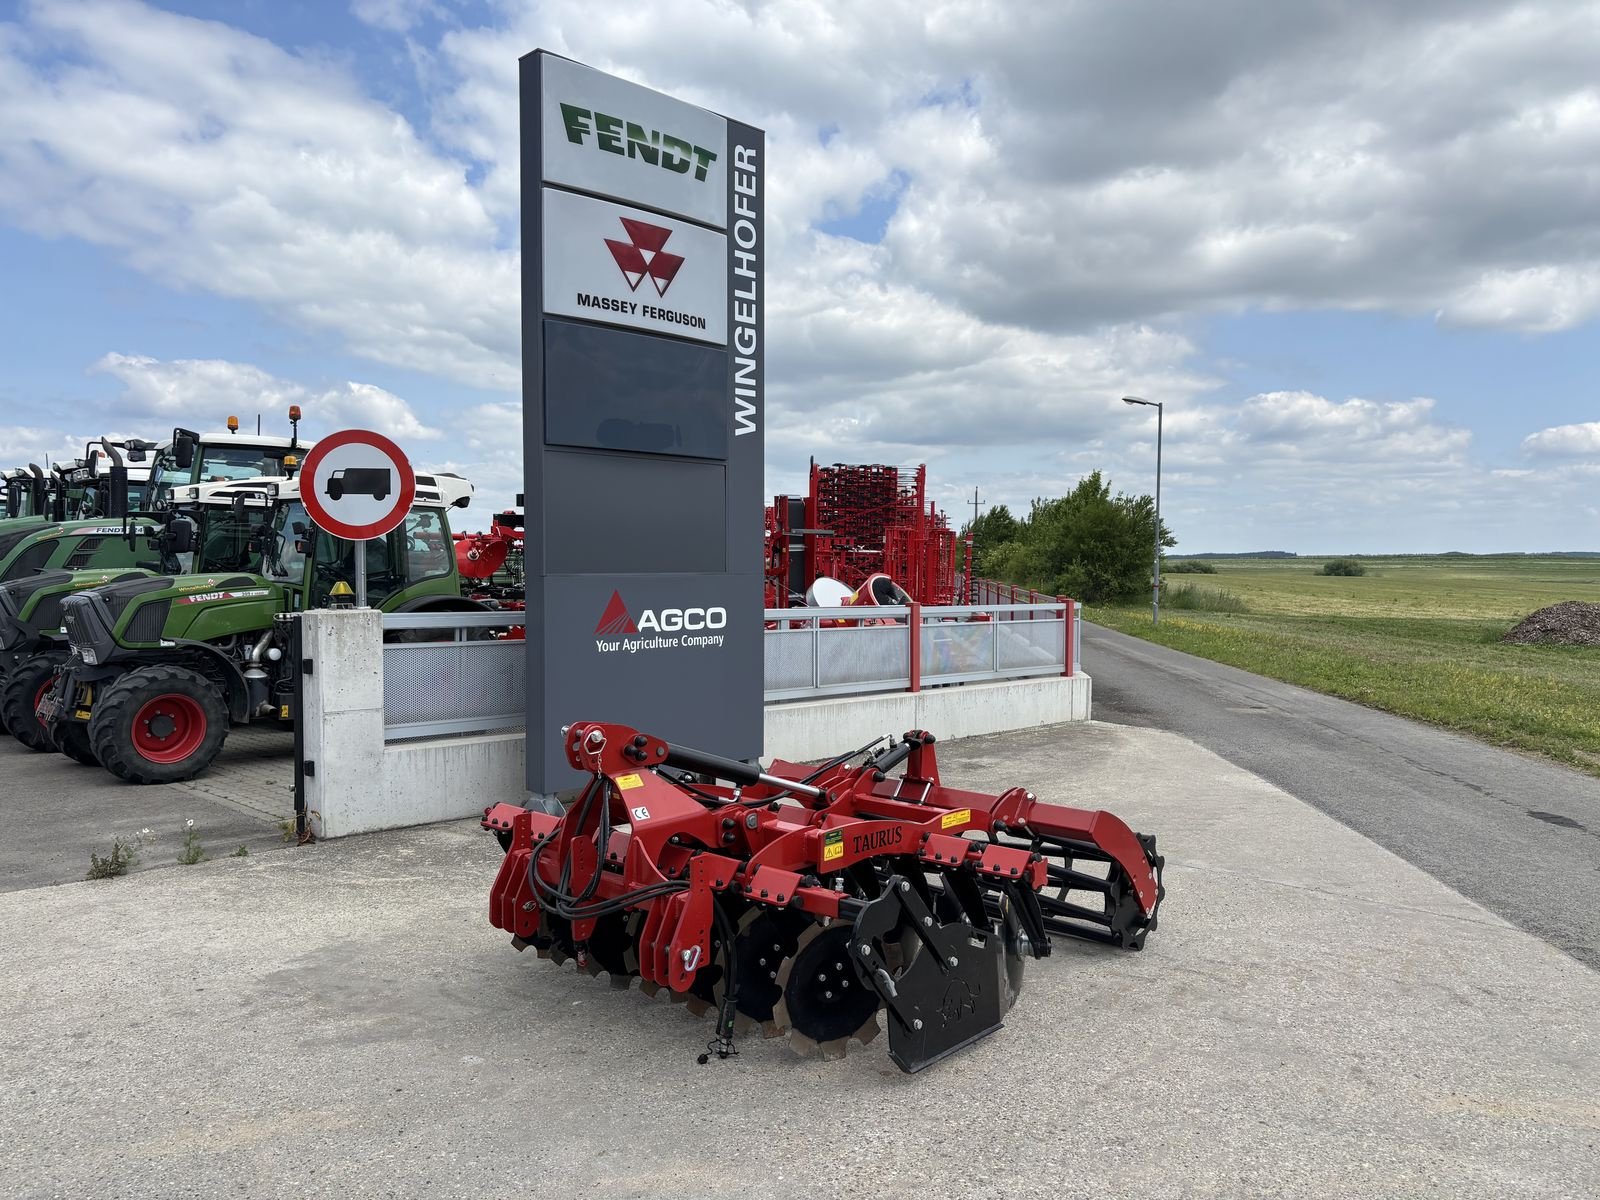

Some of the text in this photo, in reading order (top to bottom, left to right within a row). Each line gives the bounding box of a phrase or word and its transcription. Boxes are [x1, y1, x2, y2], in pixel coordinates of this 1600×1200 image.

[560, 102, 717, 182] FENDT
[734, 144, 757, 437] WINGELHOFER
[577, 293, 706, 329] MASSEY FERGUSON
[189, 592, 225, 602] FENDT
[637, 607, 727, 632] AGCO
[596, 634, 724, 654] Your Agriculture Company
[853, 826, 902, 855] TAURUS
